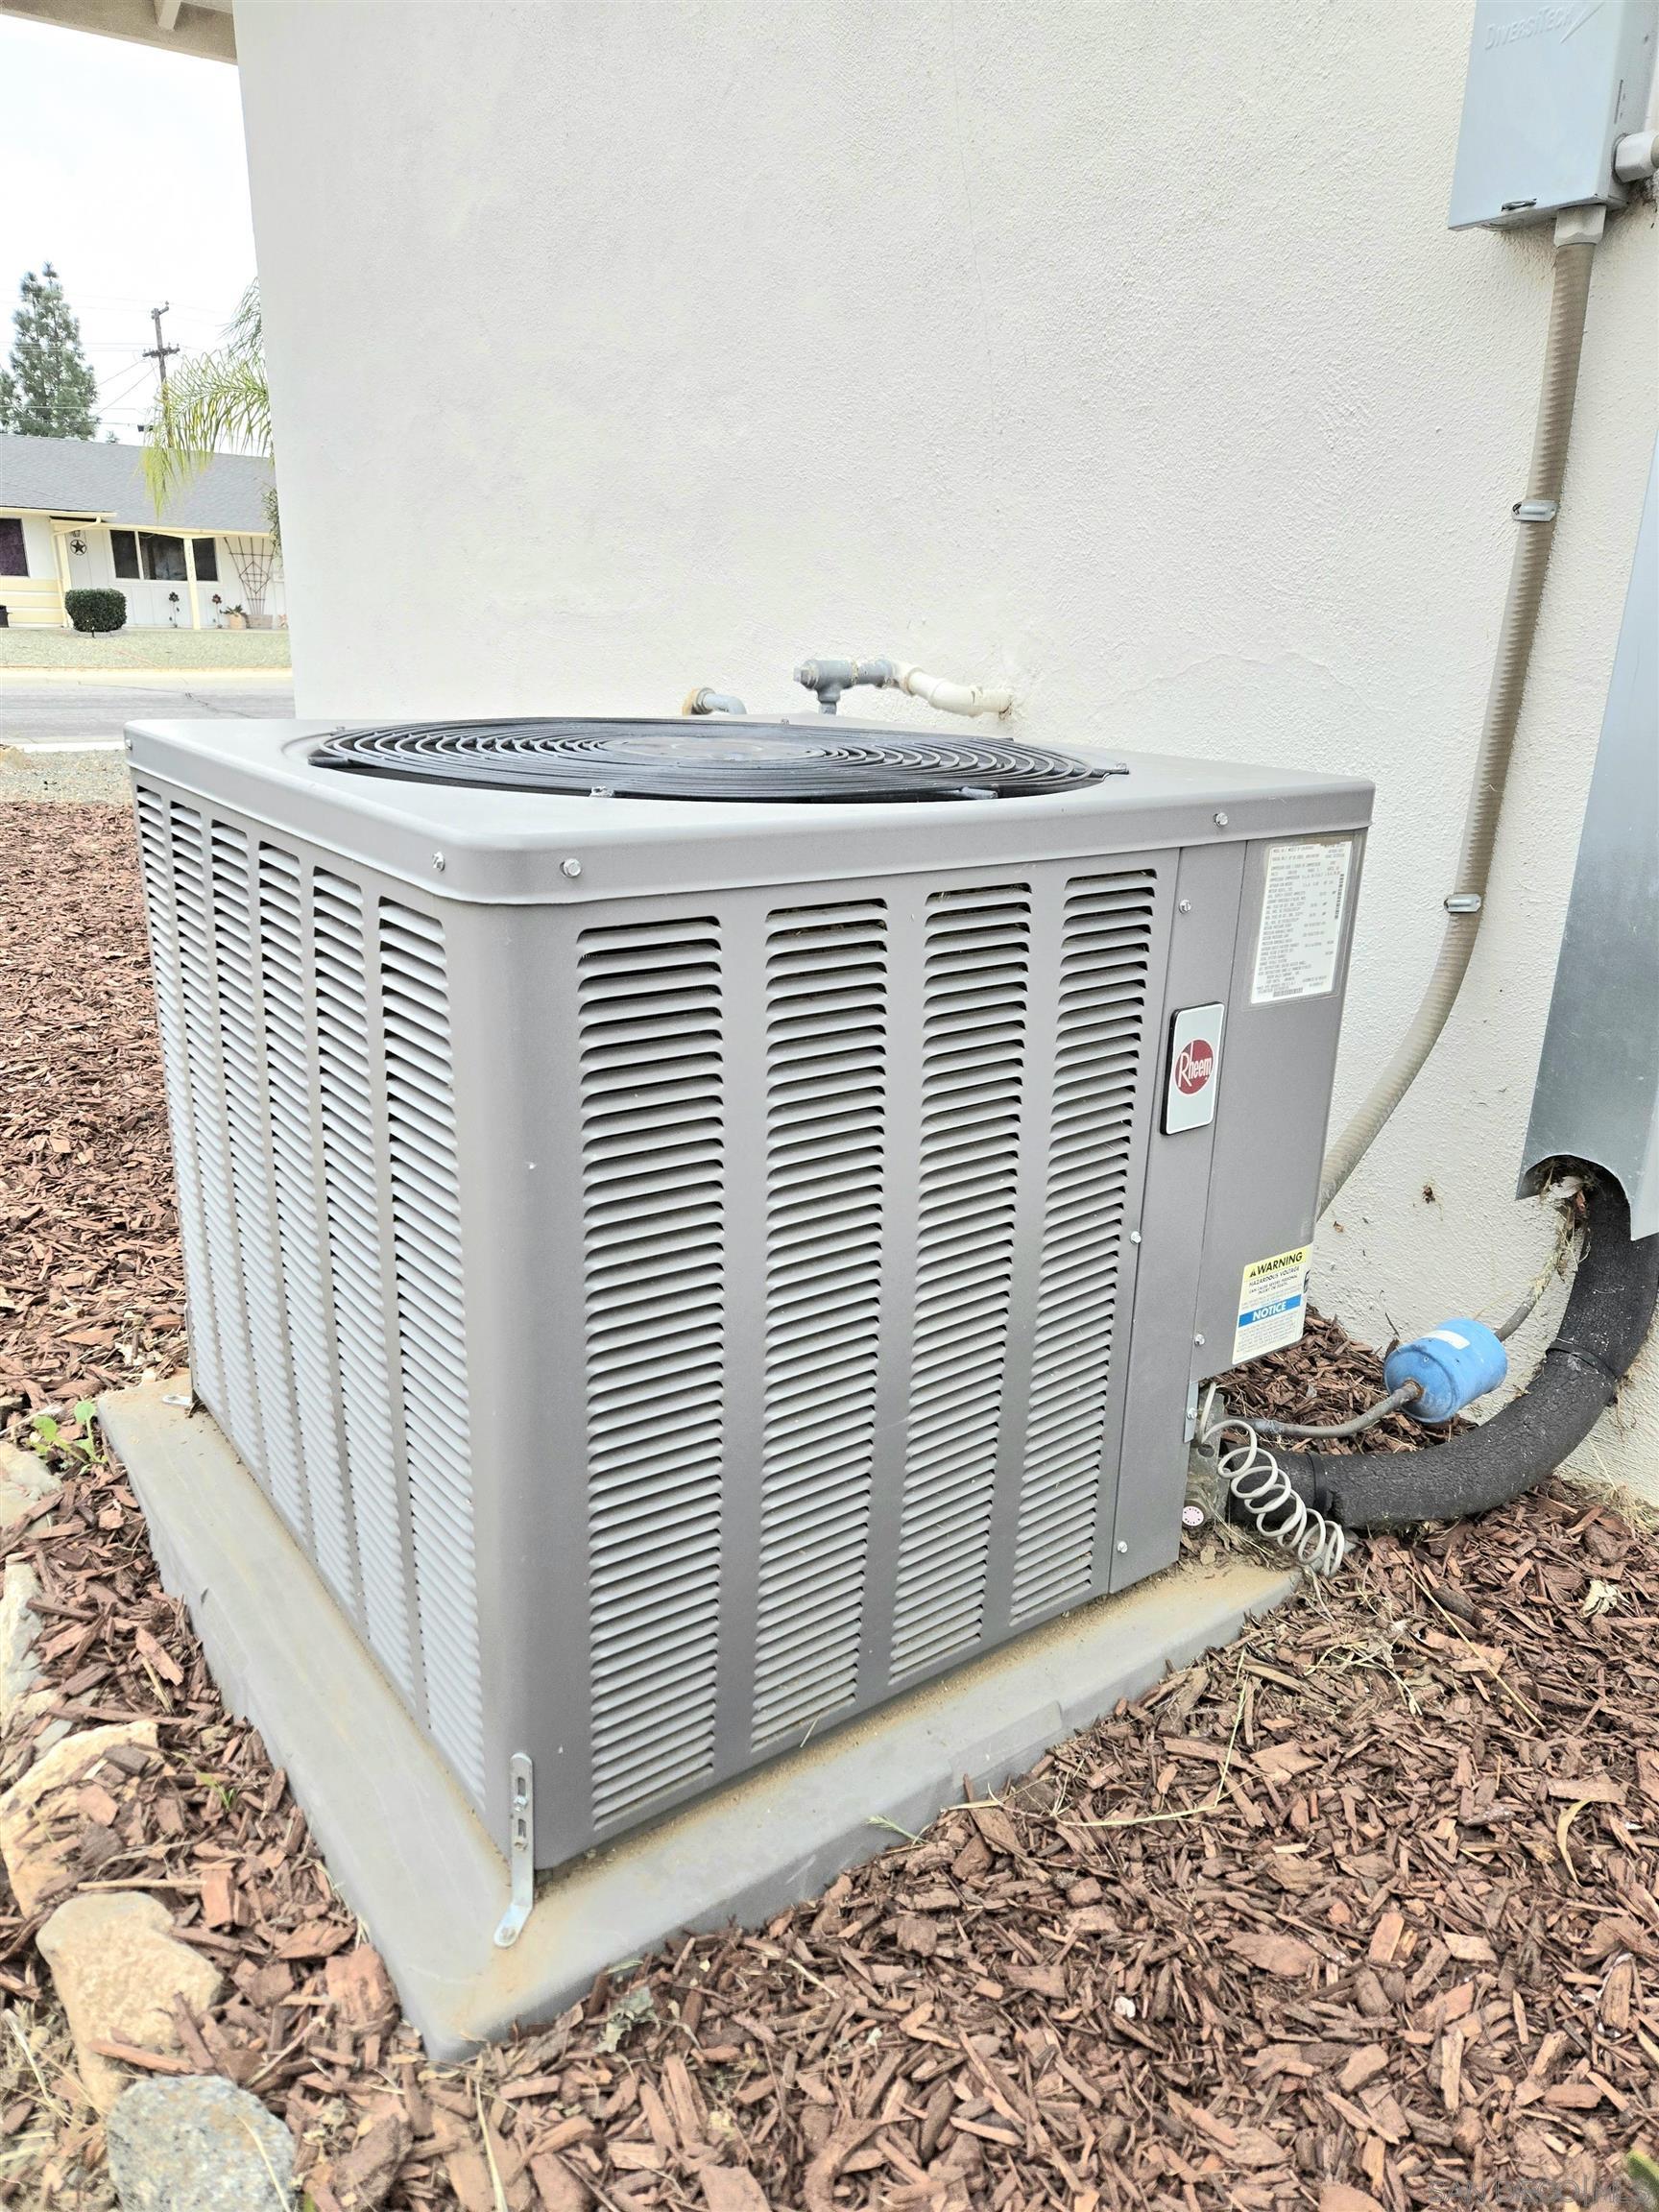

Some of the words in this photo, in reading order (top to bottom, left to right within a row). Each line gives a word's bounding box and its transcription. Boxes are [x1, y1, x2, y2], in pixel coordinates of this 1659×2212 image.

[1178, 1041, 1213, 1088] Rheem
[1257, 1252, 1303, 1275] WARNING
[1249, 1273, 1279, 1286] HAZARDOUS
[1280, 1265, 1300, 1278] VOLTAGE
[1252, 1301, 1286, 1322] NOTICE
